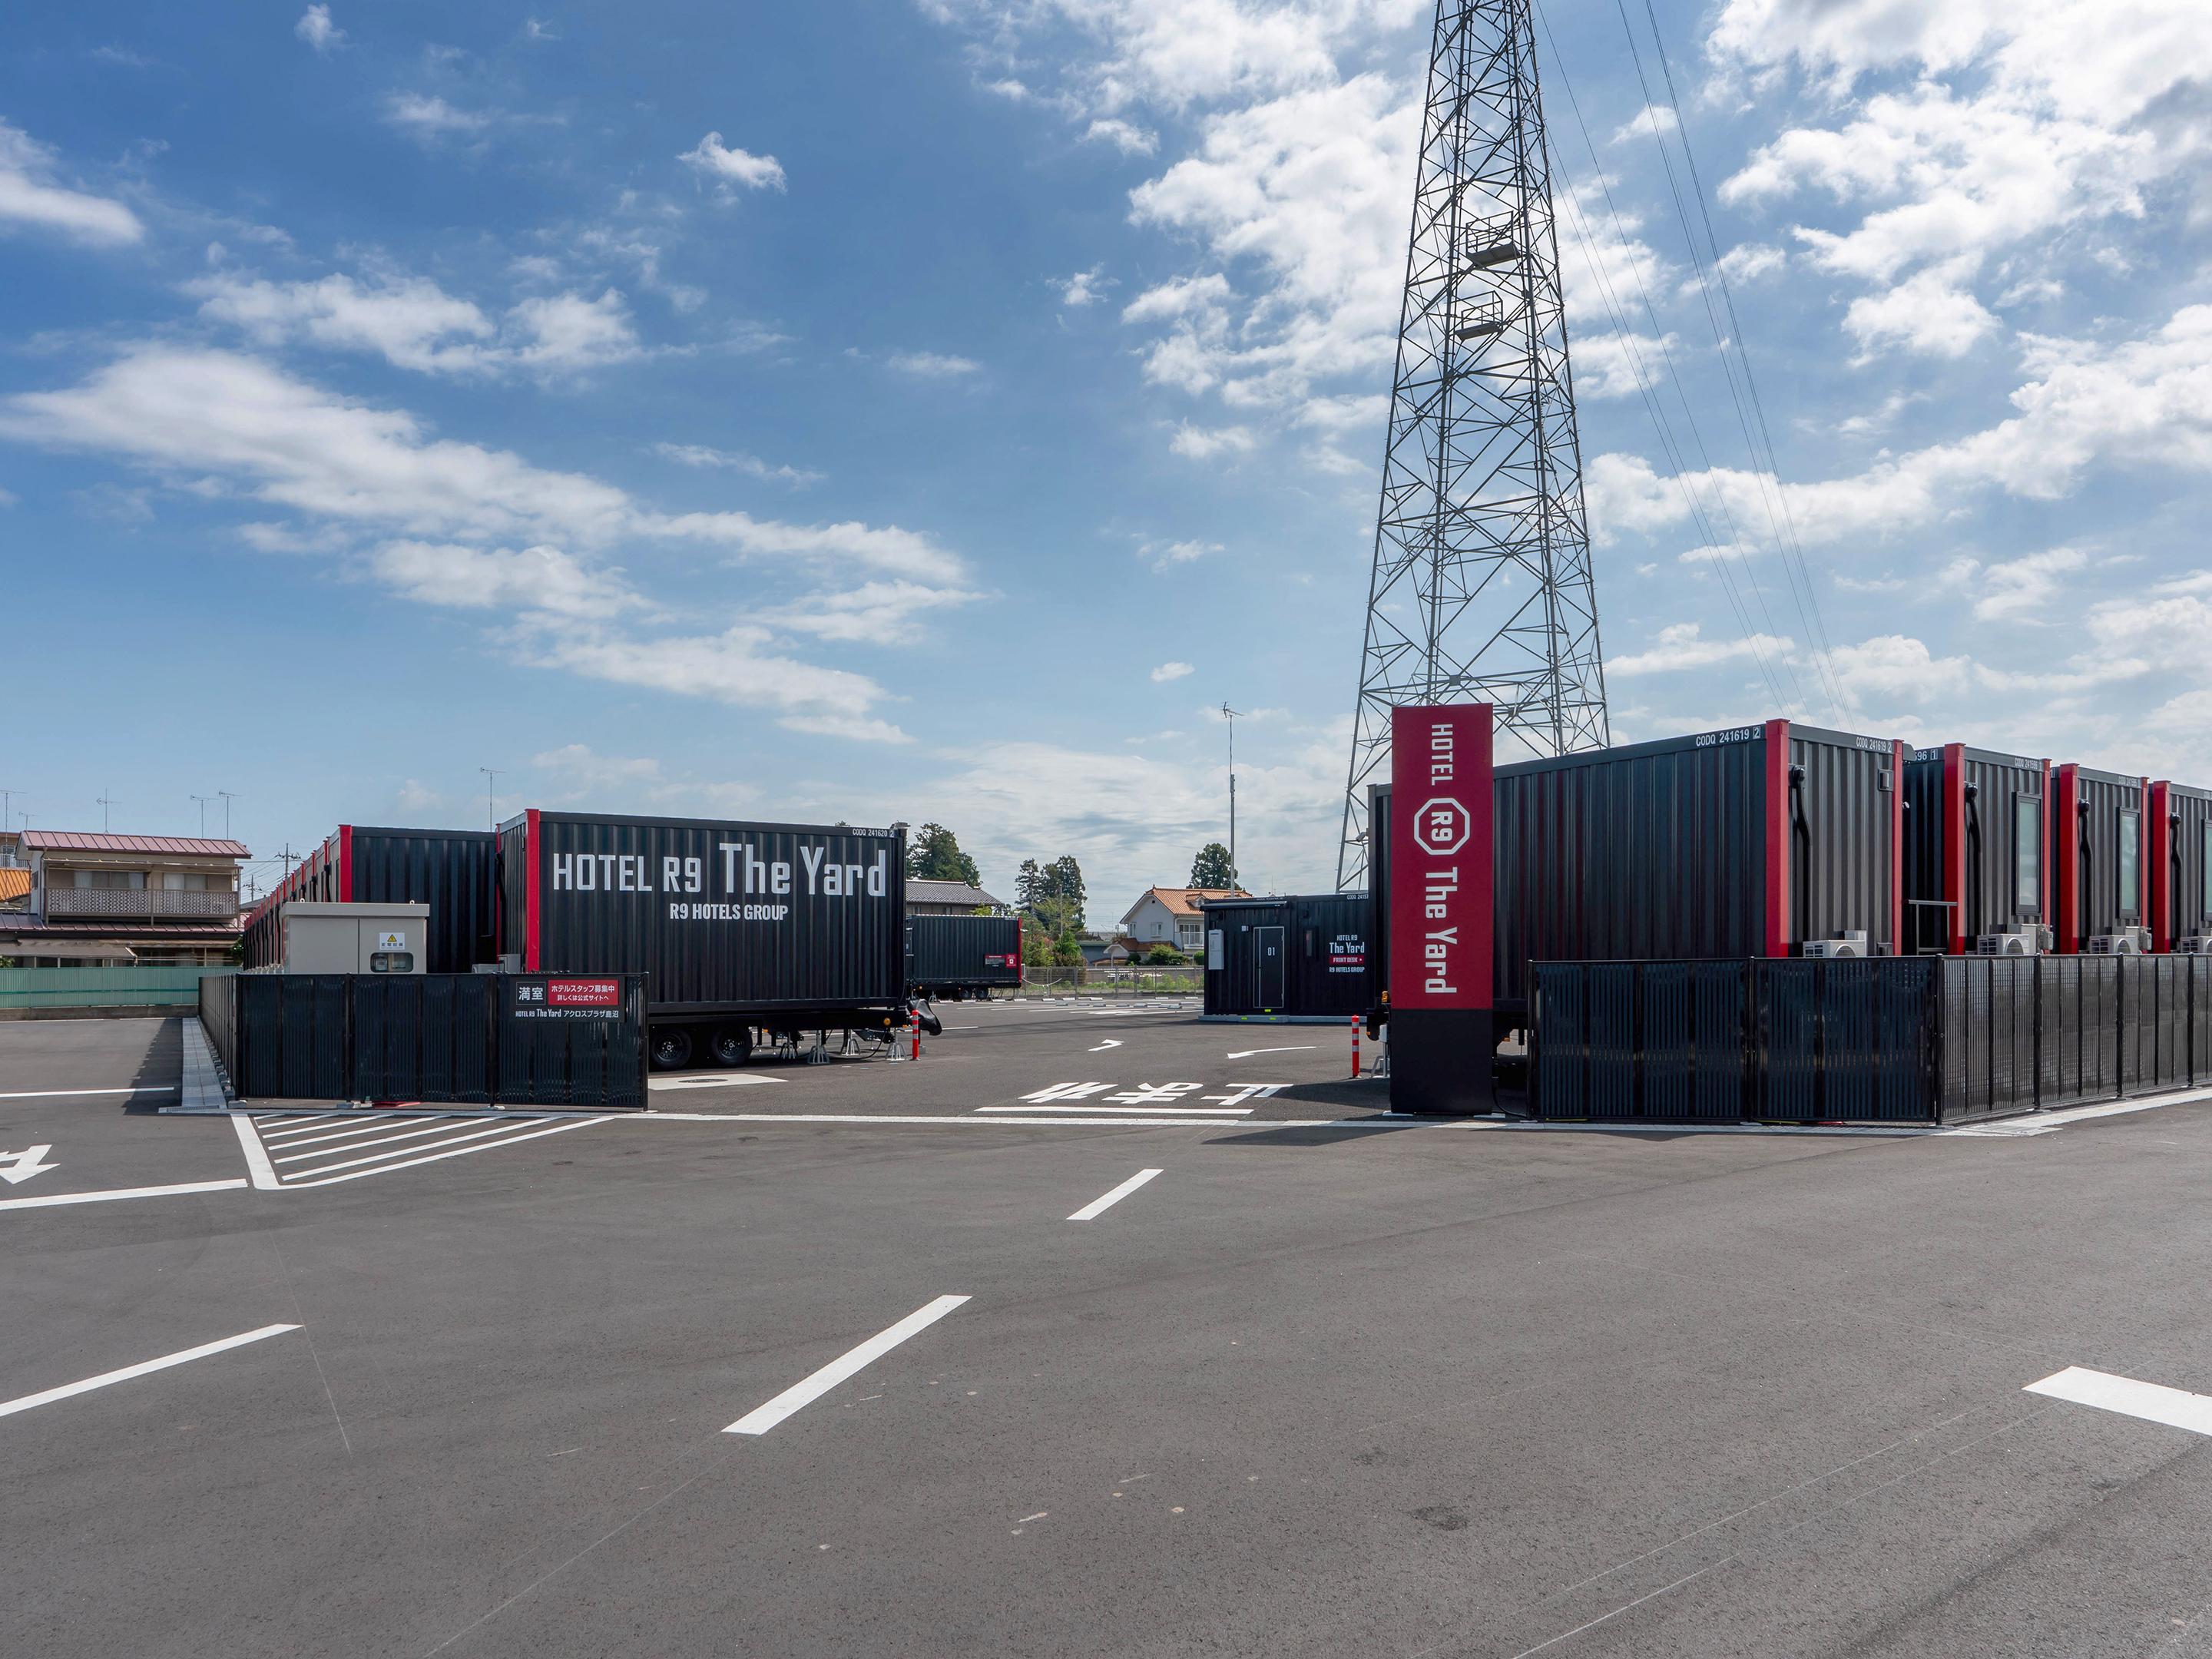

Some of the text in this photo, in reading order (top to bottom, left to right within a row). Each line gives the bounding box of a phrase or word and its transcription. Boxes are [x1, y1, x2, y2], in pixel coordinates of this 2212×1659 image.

[1696, 727, 1760, 747] CODQ 241619 2
[1869, 739, 1886, 751] 241619
[852, 828, 866, 836] CODQ
[868, 829, 888, 837] 241620
[1426, 724, 1458, 993] HOTEL R9 The Yard
[553, 843, 886, 897] HOTEL R9 The Yard
[670, 903, 789, 921] R9 HOTELS GROUP
[1267, 947, 1275, 956] 01
[1329, 942, 1365, 953] The Yard
[518, 986, 543, 1001] 満室
[536, 1008, 547, 1018] The
[548, 1008, 561, 1018] Yard
